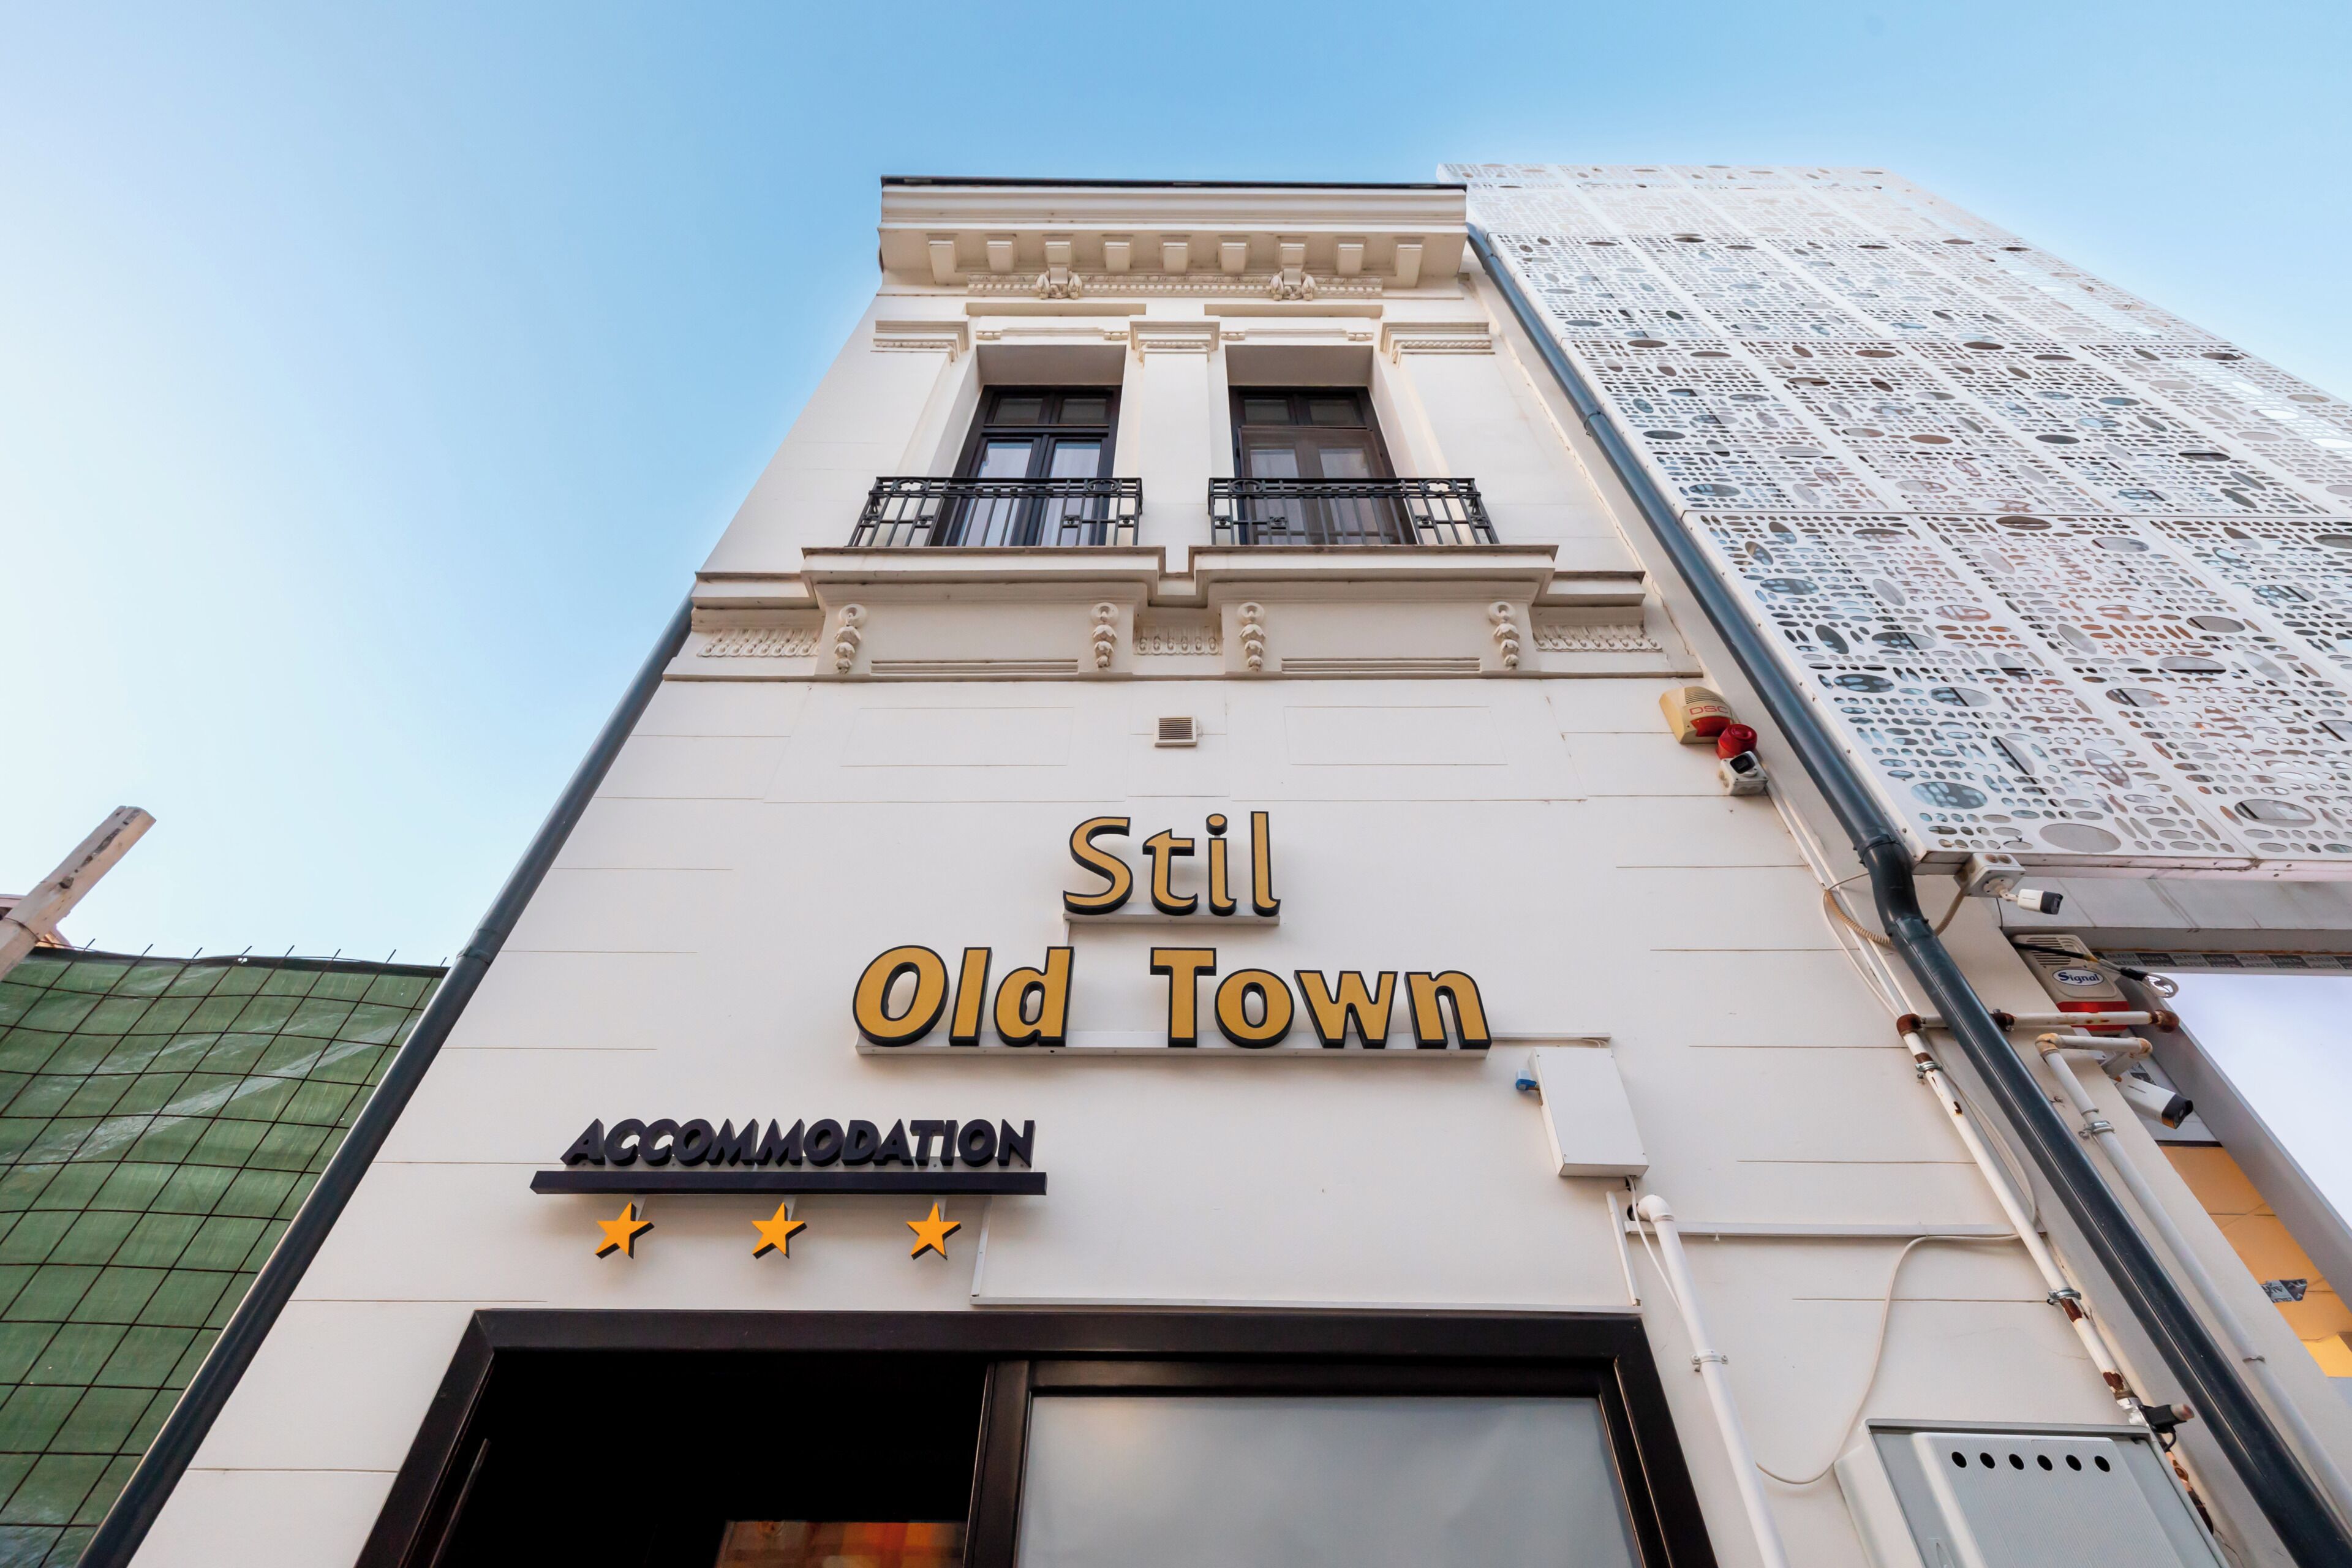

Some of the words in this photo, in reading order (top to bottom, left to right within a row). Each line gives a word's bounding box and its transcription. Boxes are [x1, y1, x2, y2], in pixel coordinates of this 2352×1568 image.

[1689, 706, 1728, 715] DSC
[1063, 811, 1281, 918] Stil
[853, 945, 1075, 1048] Old
[1150, 947, 1492, 1050] Town
[2058, 971, 2100, 984] Signal
[560, 1118, 1036, 1168] ACCOMMODATION
